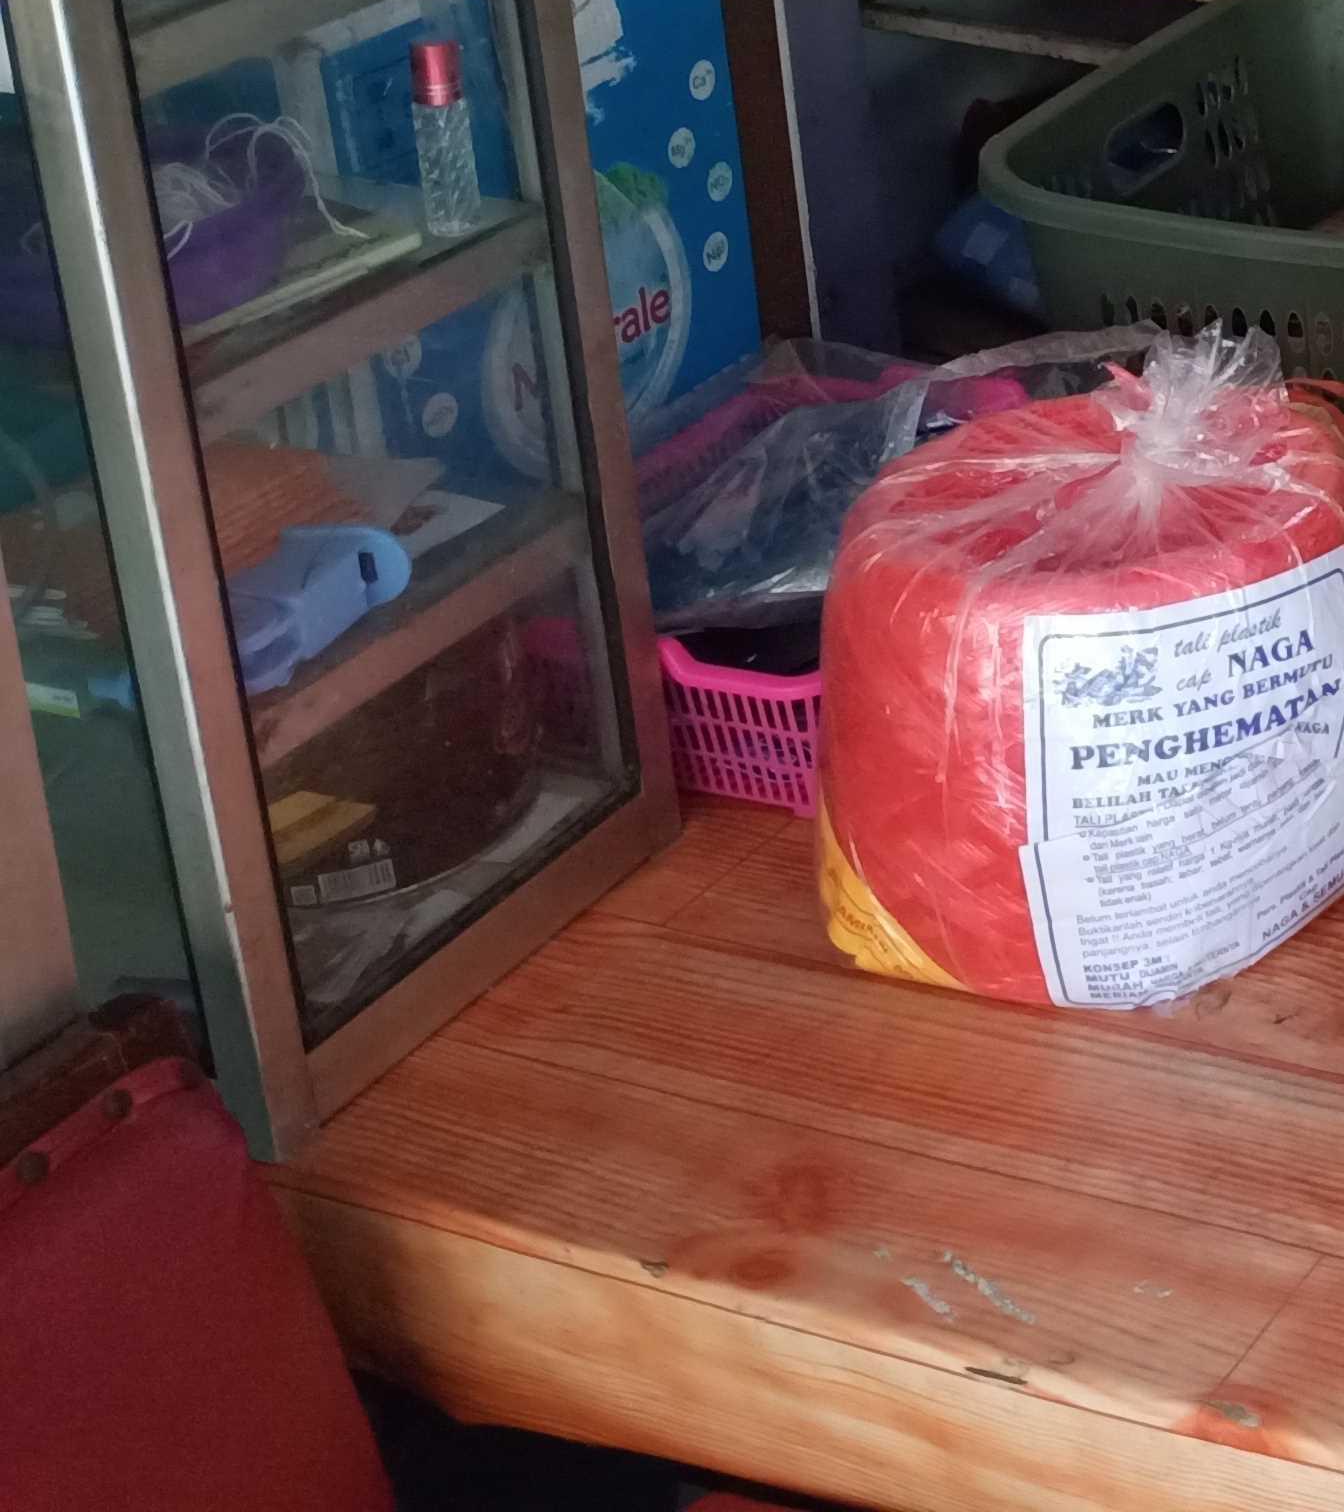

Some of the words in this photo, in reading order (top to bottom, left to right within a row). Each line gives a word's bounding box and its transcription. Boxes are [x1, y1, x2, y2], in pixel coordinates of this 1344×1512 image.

[1173, 637, 1208, 658] tali
[1217, 610, 1282, 651] plastik
[1176, 669, 1212, 691] cap
[1227, 629, 1314, 678] NAGA
[1092, 706, 1164, 729] MERK
[1174, 690, 1235, 718] YANG
[1243, 654, 1333, 700] BERMUTU
[1069, 678, 1341, 770] PENGHEMATAN
[1138, 768, 1178, 786] MAU
[1072, 791, 1151, 809] BELILAH
[1074, 815, 1101, 825] TALI
[1261, 909, 1299, 941] NAGA
[1083, 959, 1139, 973] KONSEP
[1143, 955, 1162, 968] 3M
[1086, 972, 1130, 982] MUTU
